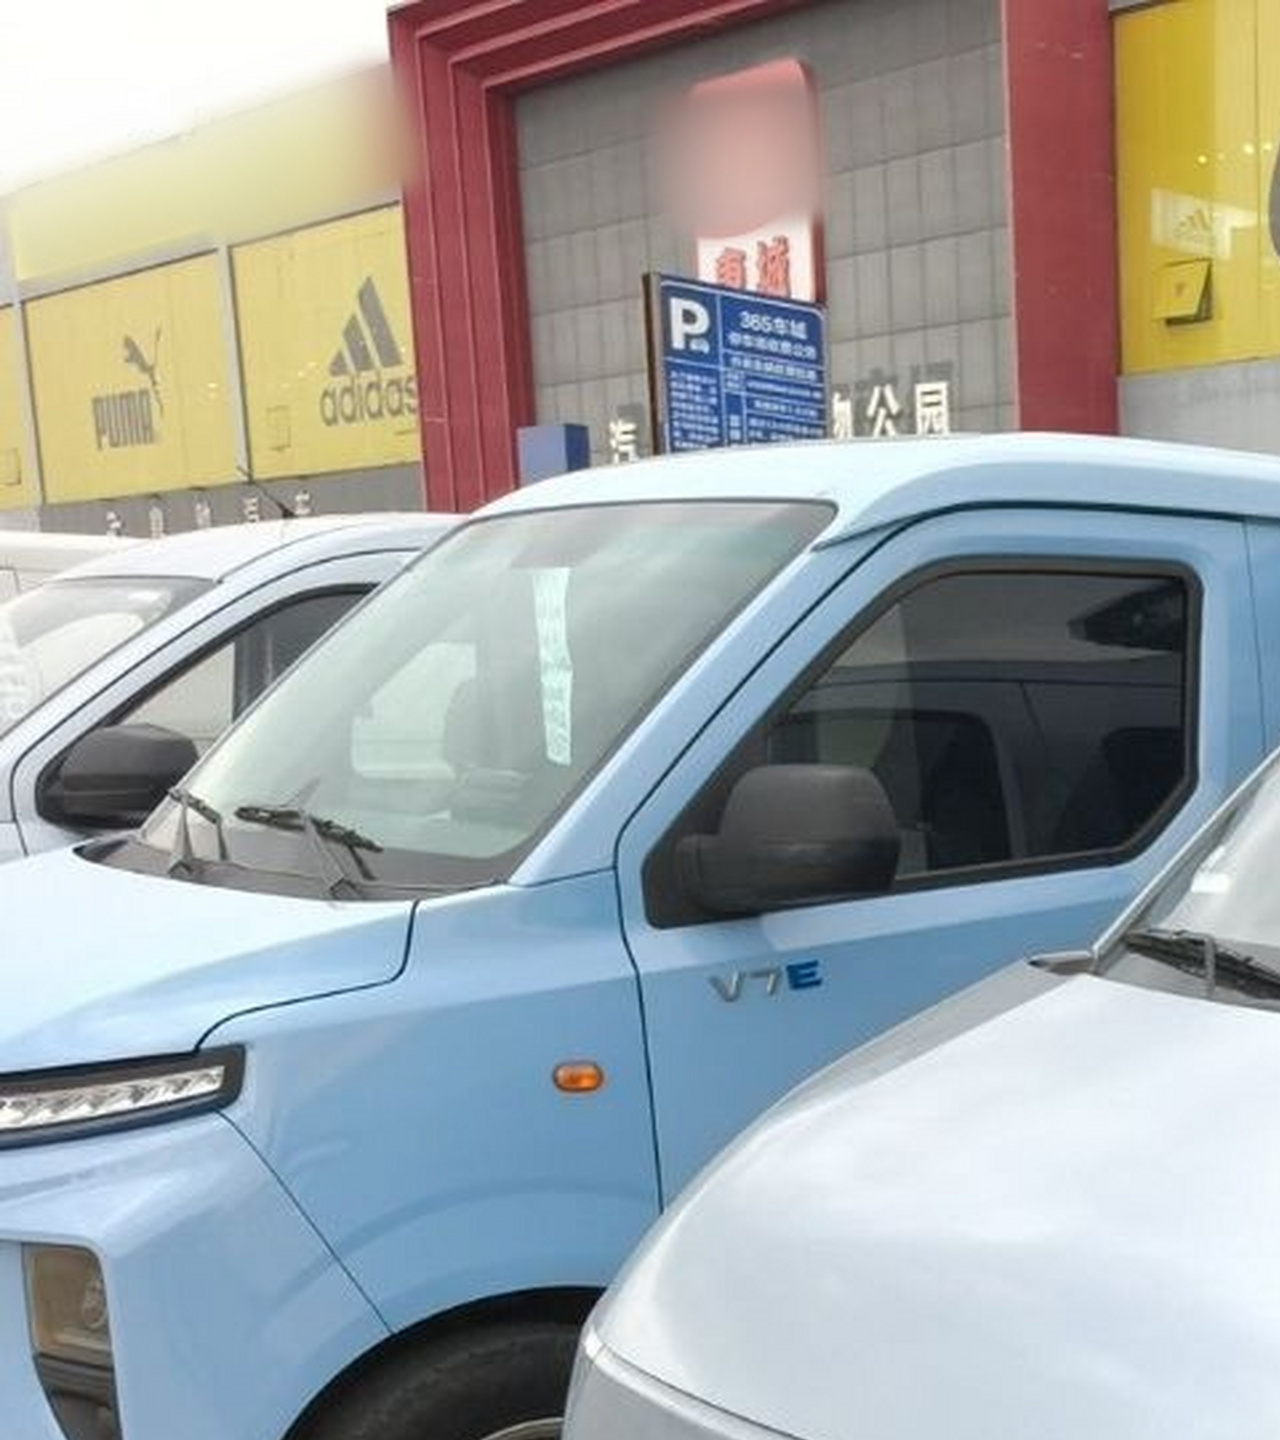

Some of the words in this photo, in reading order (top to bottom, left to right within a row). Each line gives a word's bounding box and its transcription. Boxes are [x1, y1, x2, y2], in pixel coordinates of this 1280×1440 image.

[92, 388, 155, 451] PUMA
[320, 370, 417, 427] adidas
[708, 960, 822, 1002] V7E
